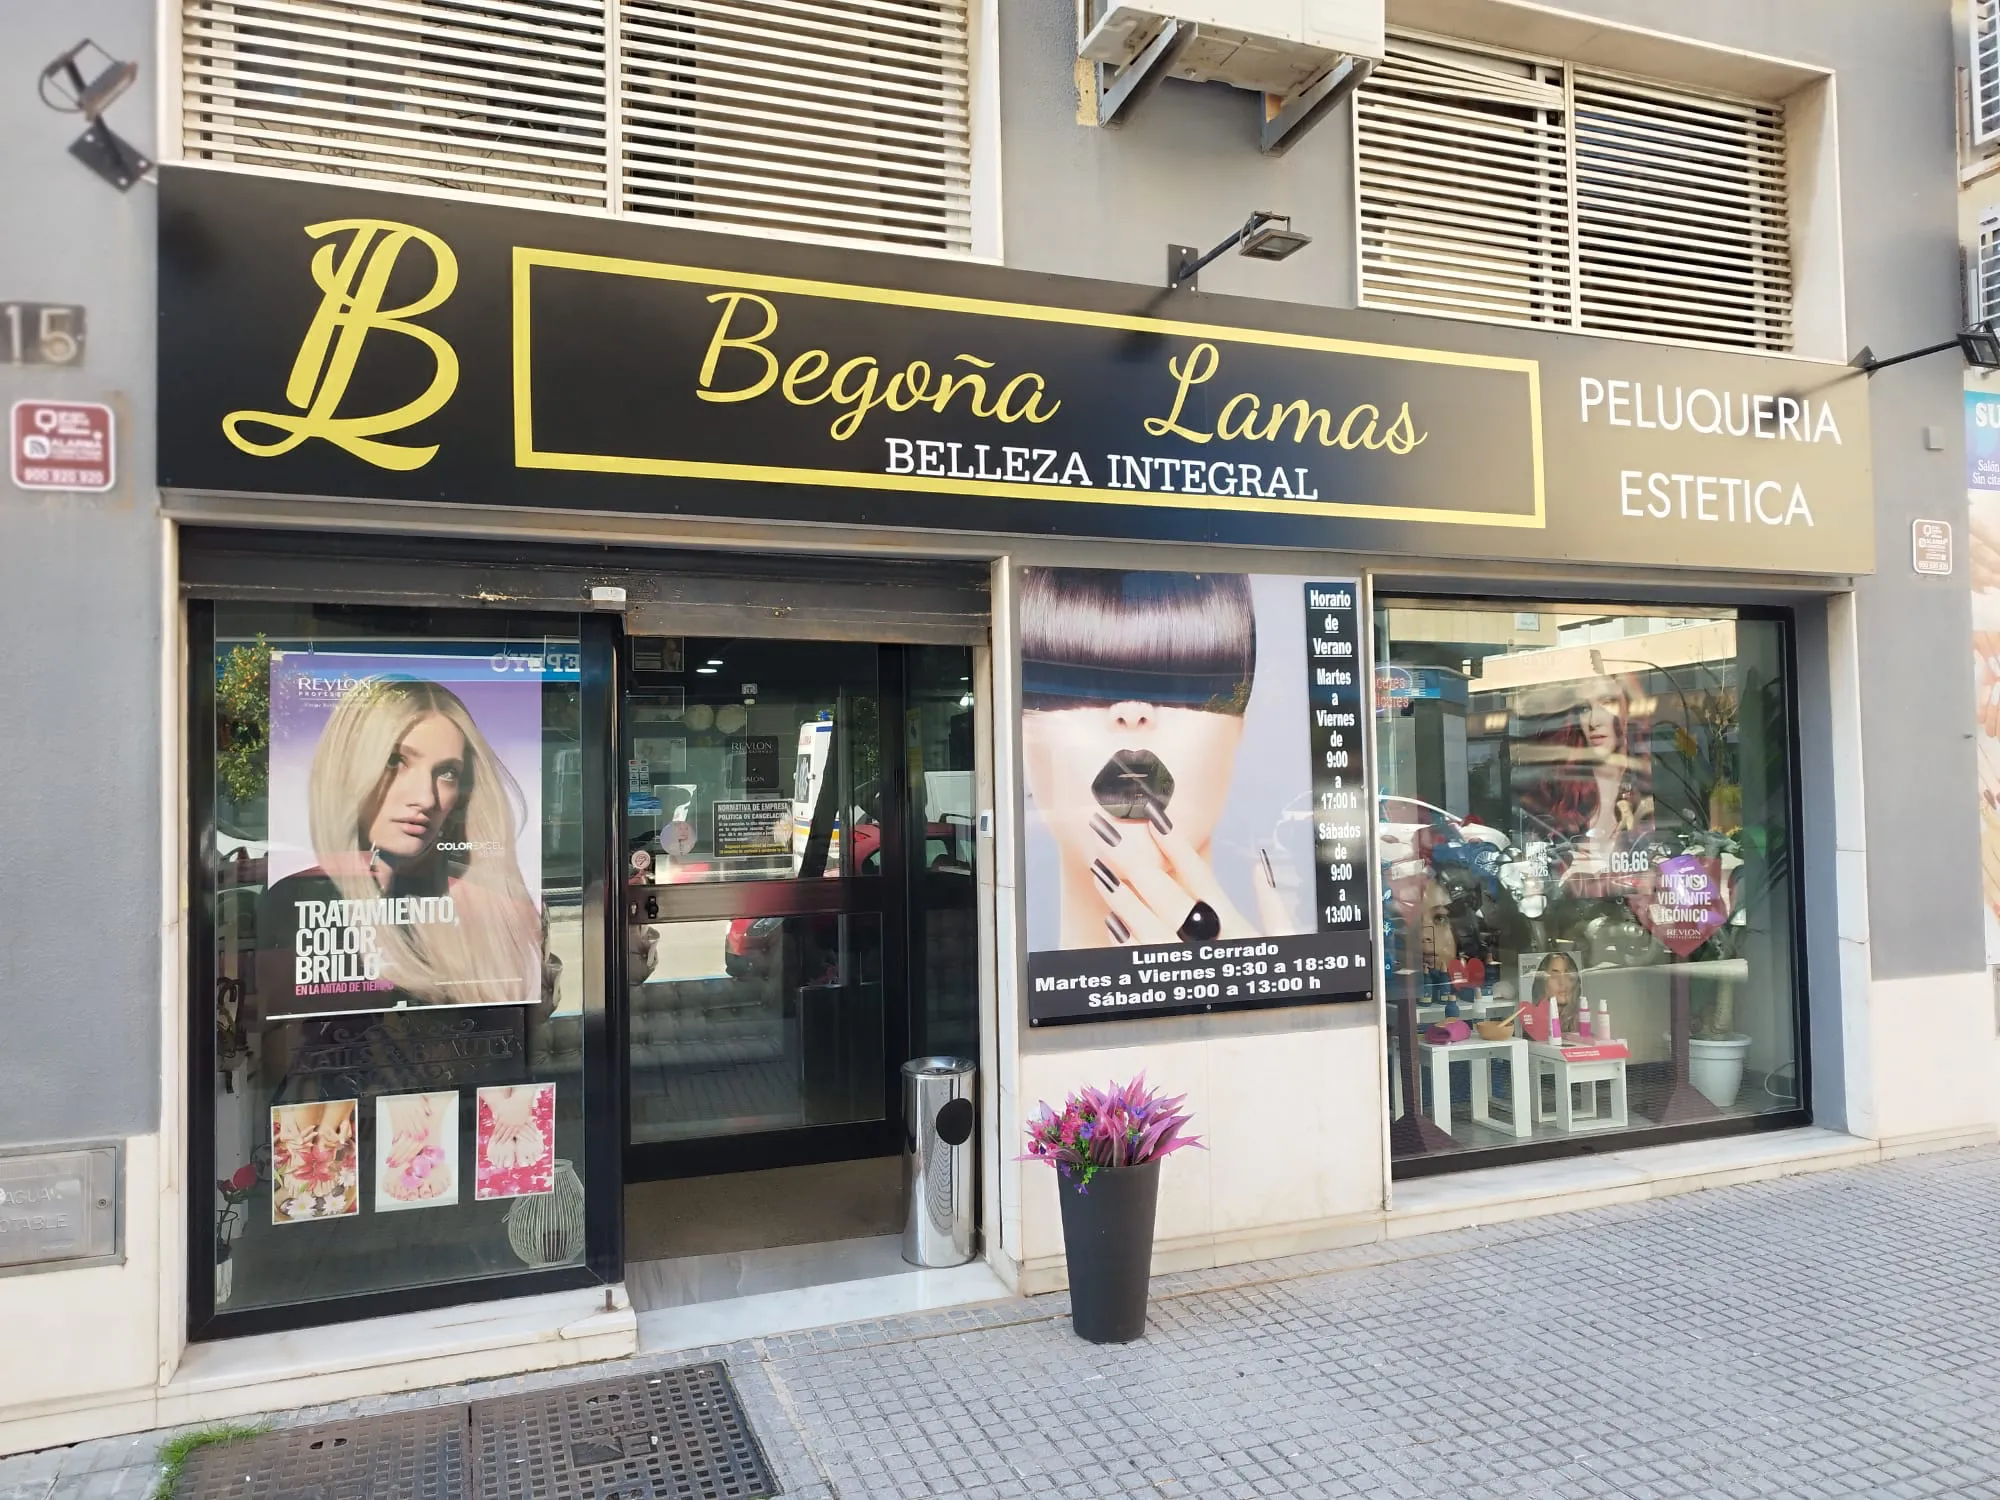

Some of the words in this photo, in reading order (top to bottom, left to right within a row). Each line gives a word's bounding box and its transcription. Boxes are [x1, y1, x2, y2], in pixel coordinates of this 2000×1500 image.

[5, 304, 77, 362] 15
[697, 292, 1061, 441] Begoña
[1144, 342, 1427, 456] Lamas
[1580, 376, 1843, 445] PELUQUERIA
[885, 437, 1093, 487] BELLEZA
[1107, 454, 1319, 501] INTEGRAL
[1620, 470, 1815, 527] ESTETICA
[1310, 589, 1351, 607] Horario
[1324, 614, 1339, 631] de
[1313, 637, 1352, 655] Verano
[298, 677, 371, 691] REVLON
[1317, 668, 1351, 685] Martes
[1331, 692, 1339, 706] a
[1316, 709, 1355, 727] Viernes
[1330, 730, 1343, 747] de
[1326, 750, 1348, 768] 9:00
[1335, 775, 1341, 789] a
[1321, 792, 1349, 810] 17:00
[1350, 791, 1357, 809] h
[1319, 822, 1361, 840] Sábados
[1334, 843, 1347, 860] de
[1612, 851, 1649, 873] 66.66
[1331, 863, 1352, 881] 9:00
[1661, 874, 1708, 889] INTENSO
[1339, 888, 1346, 901] a
[1657, 891, 1712, 906] VIBRANTE
[294, 896, 460, 928] TRATAMIENTO,
[1325, 905, 1352, 924] 13:00
[1354, 904, 1361, 922] h
[1667, 928, 1702, 937] REVLON
[1132, 950, 1193, 965] Lunes
[1199, 943, 1279, 960] Cerrado
[1035, 974, 1112, 992] Martes
[1118, 973, 1132, 986] a
[1138, 966, 1216, 984] Viernes
[1222, 961, 1268, 977] 9:30
[1274, 962, 1286, 974] a
[1293, 955, 1349, 972] 18:30
[1354, 954, 1366, 968] h
[295, 984, 308, 996] EN
[309, 983, 320, 995] LA
[321, 982, 347, 994] MITAD
[349, 981, 361, 992] DE
[1088, 988, 1167, 1008] Sábado
[1173, 983, 1220, 1001] 9:00
[1226, 984, 1239, 996] a
[1246, 977, 1303, 994] 13:00
[1309, 976, 1321, 989] h
